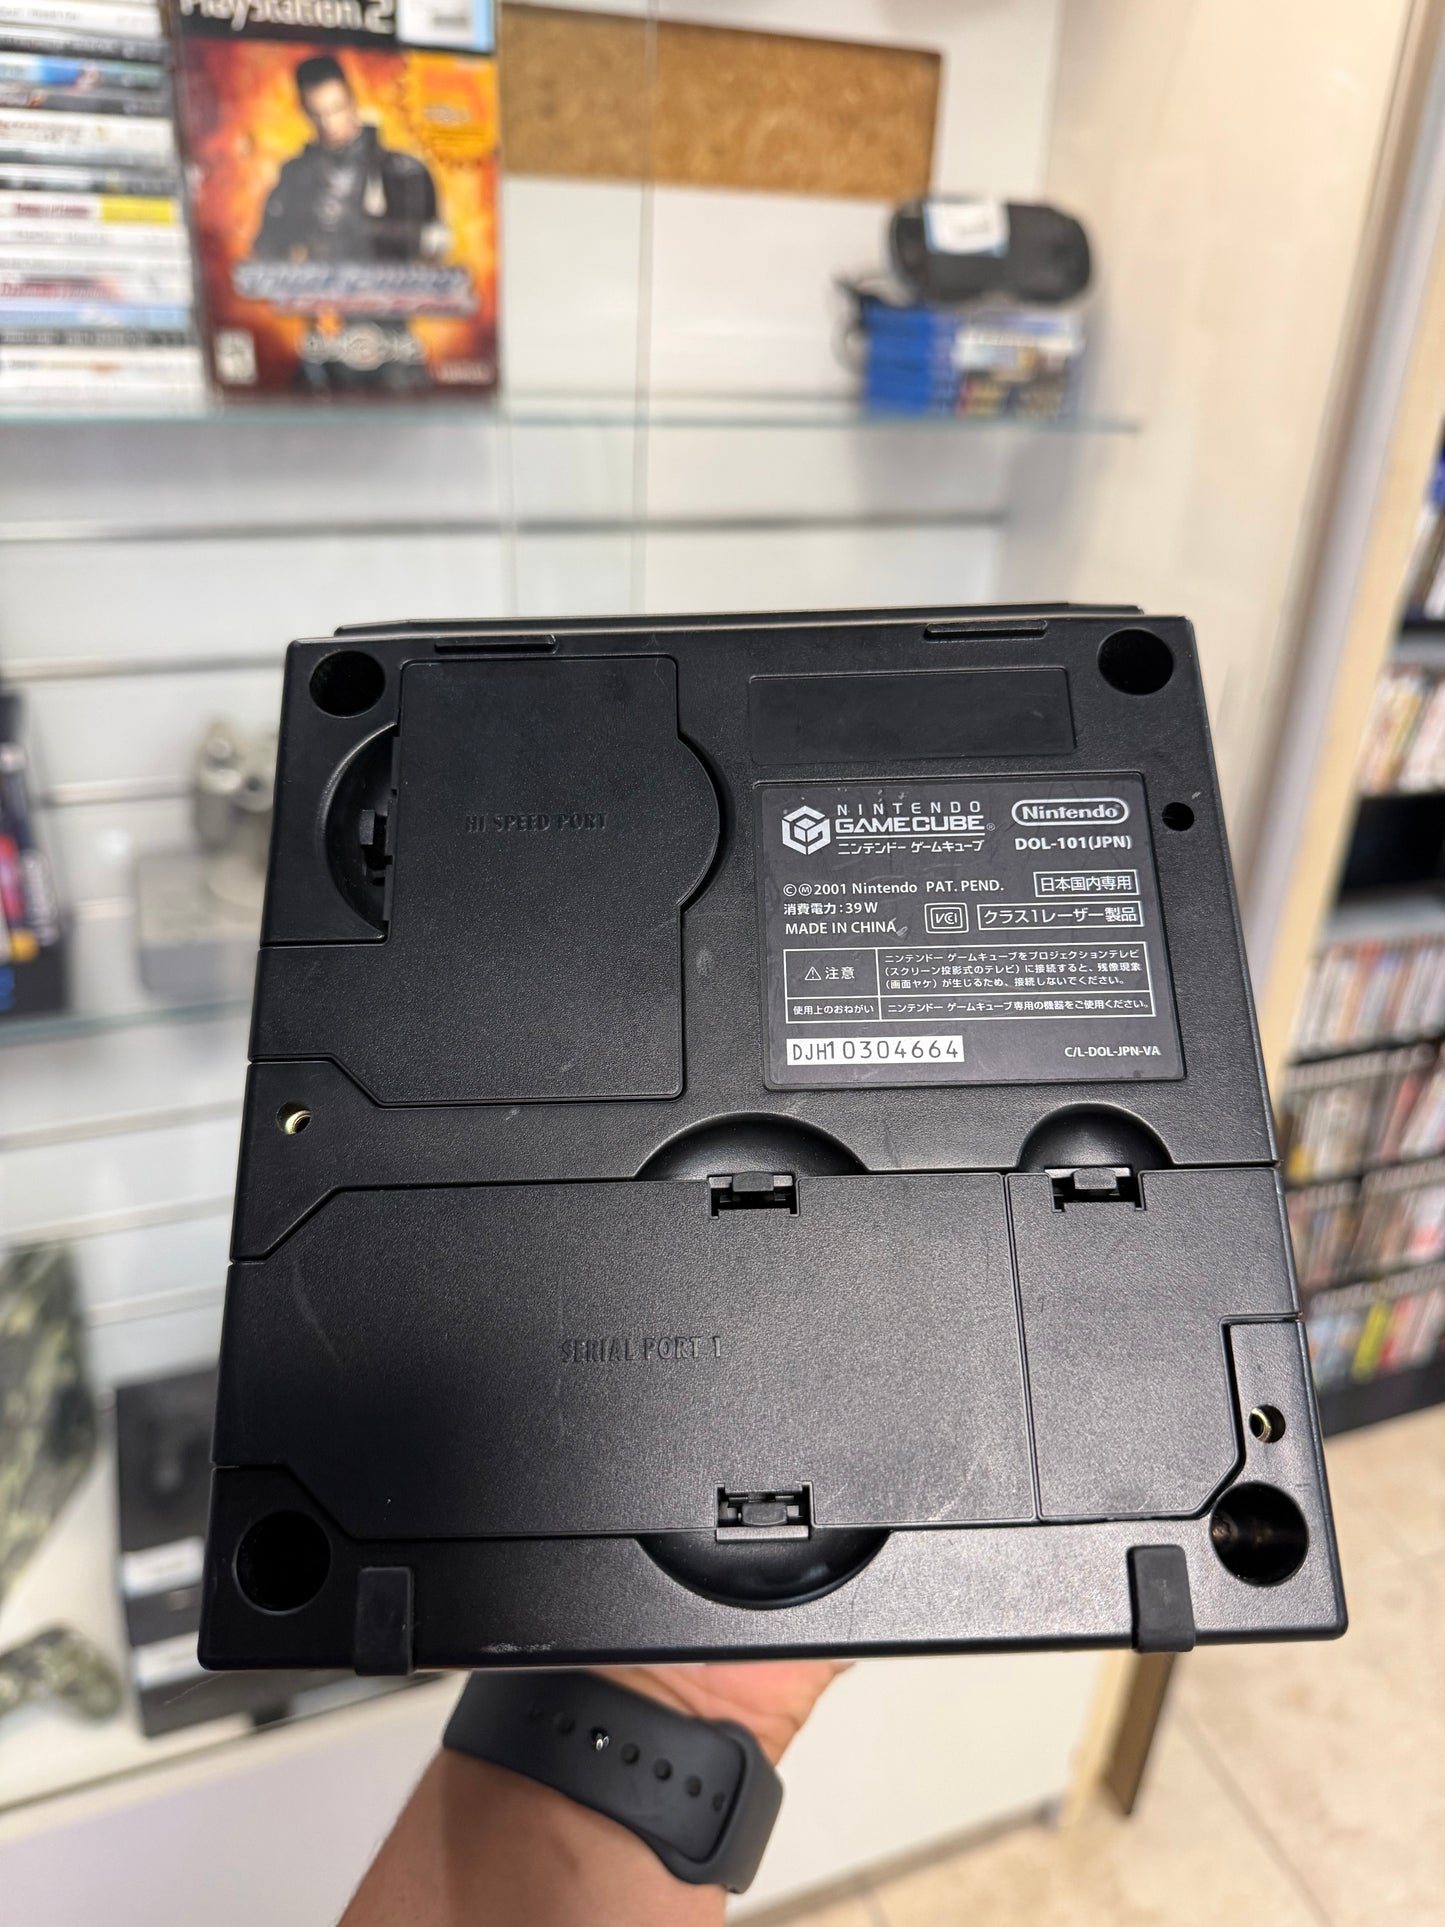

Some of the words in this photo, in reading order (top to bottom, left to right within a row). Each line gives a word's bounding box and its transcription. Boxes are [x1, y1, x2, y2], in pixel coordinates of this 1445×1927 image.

[837, 800, 981, 816] NINTENDO
[1021, 804, 1119, 820] Nintendo
[466, 813, 487, 833] HI
[494, 812, 550, 832] SPEED
[557, 811, 607, 831] PORT
[838, 841, 906, 855] ニンテンドー
[911, 839, 985, 854] ゲームキューブ
[1015, 835, 1132, 850] DOL-101(JPN)
[852, 881, 918, 895] Nintendo
[926, 880, 958, 893] PAT.
[961, 879, 1004, 892] PEND.
[1040, 875, 1132, 892] 日本国内専用
[984, 906, 1137, 924] クラス1レーザー製品
[785, 922, 828, 935] MADE
[832, 921, 847, 934] IN
[851, 920, 897, 933] CHINA
[825, 966, 855, 980] 注意
[793, 1004, 874, 1016] 使用上のおねがい
[1064, 1045, 1161, 1058] C/L-DOL-JPN-VA
[561, 1337, 637, 1363] SERIAL
[644, 1336, 702, 1360] PORT
[713, 1335, 721, 1359] 1
